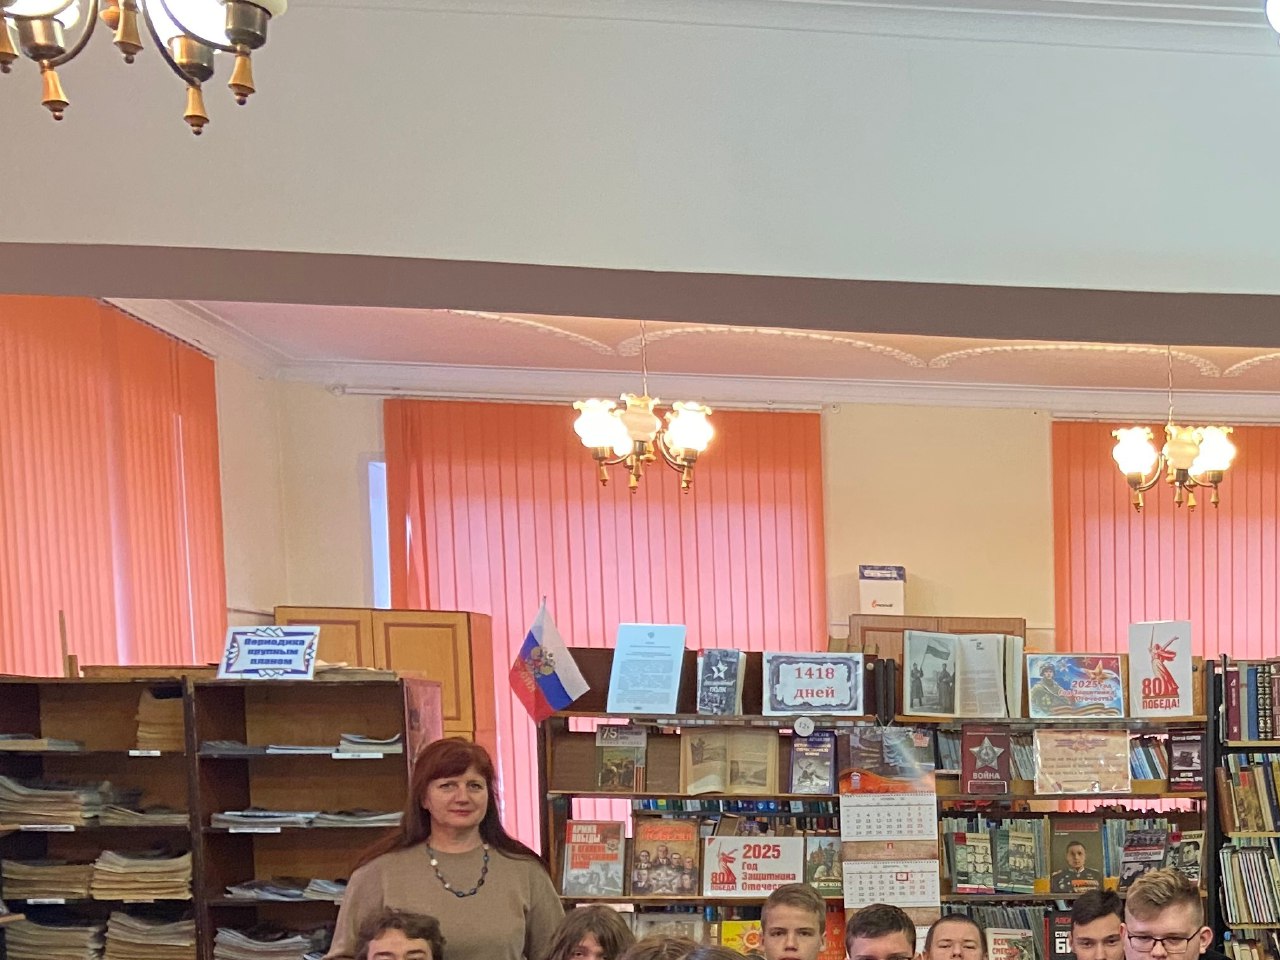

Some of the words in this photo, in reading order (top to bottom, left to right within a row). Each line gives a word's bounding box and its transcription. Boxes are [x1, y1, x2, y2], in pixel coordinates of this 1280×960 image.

[244, 638, 305, 646] Периодика
[794, 667, 835, 680] 1418
[1071, 680, 1098, 688] 2025
[1142, 677, 1162, 696] 80
[793, 687, 835, 700] дней
[1142, 699, 1180, 710] ПОБЕДА!
[602, 727, 618, 739] 75
[972, 771, 1001, 779] ВОЙНА
[742, 844, 781, 859] 2025
[741, 862, 758, 871] Год
[711, 872, 725, 882] 80
[741, 872, 796, 882] Защитника
[710, 884, 737, 892] ПОБЕДА!
[741, 882, 783, 891] Отечес
